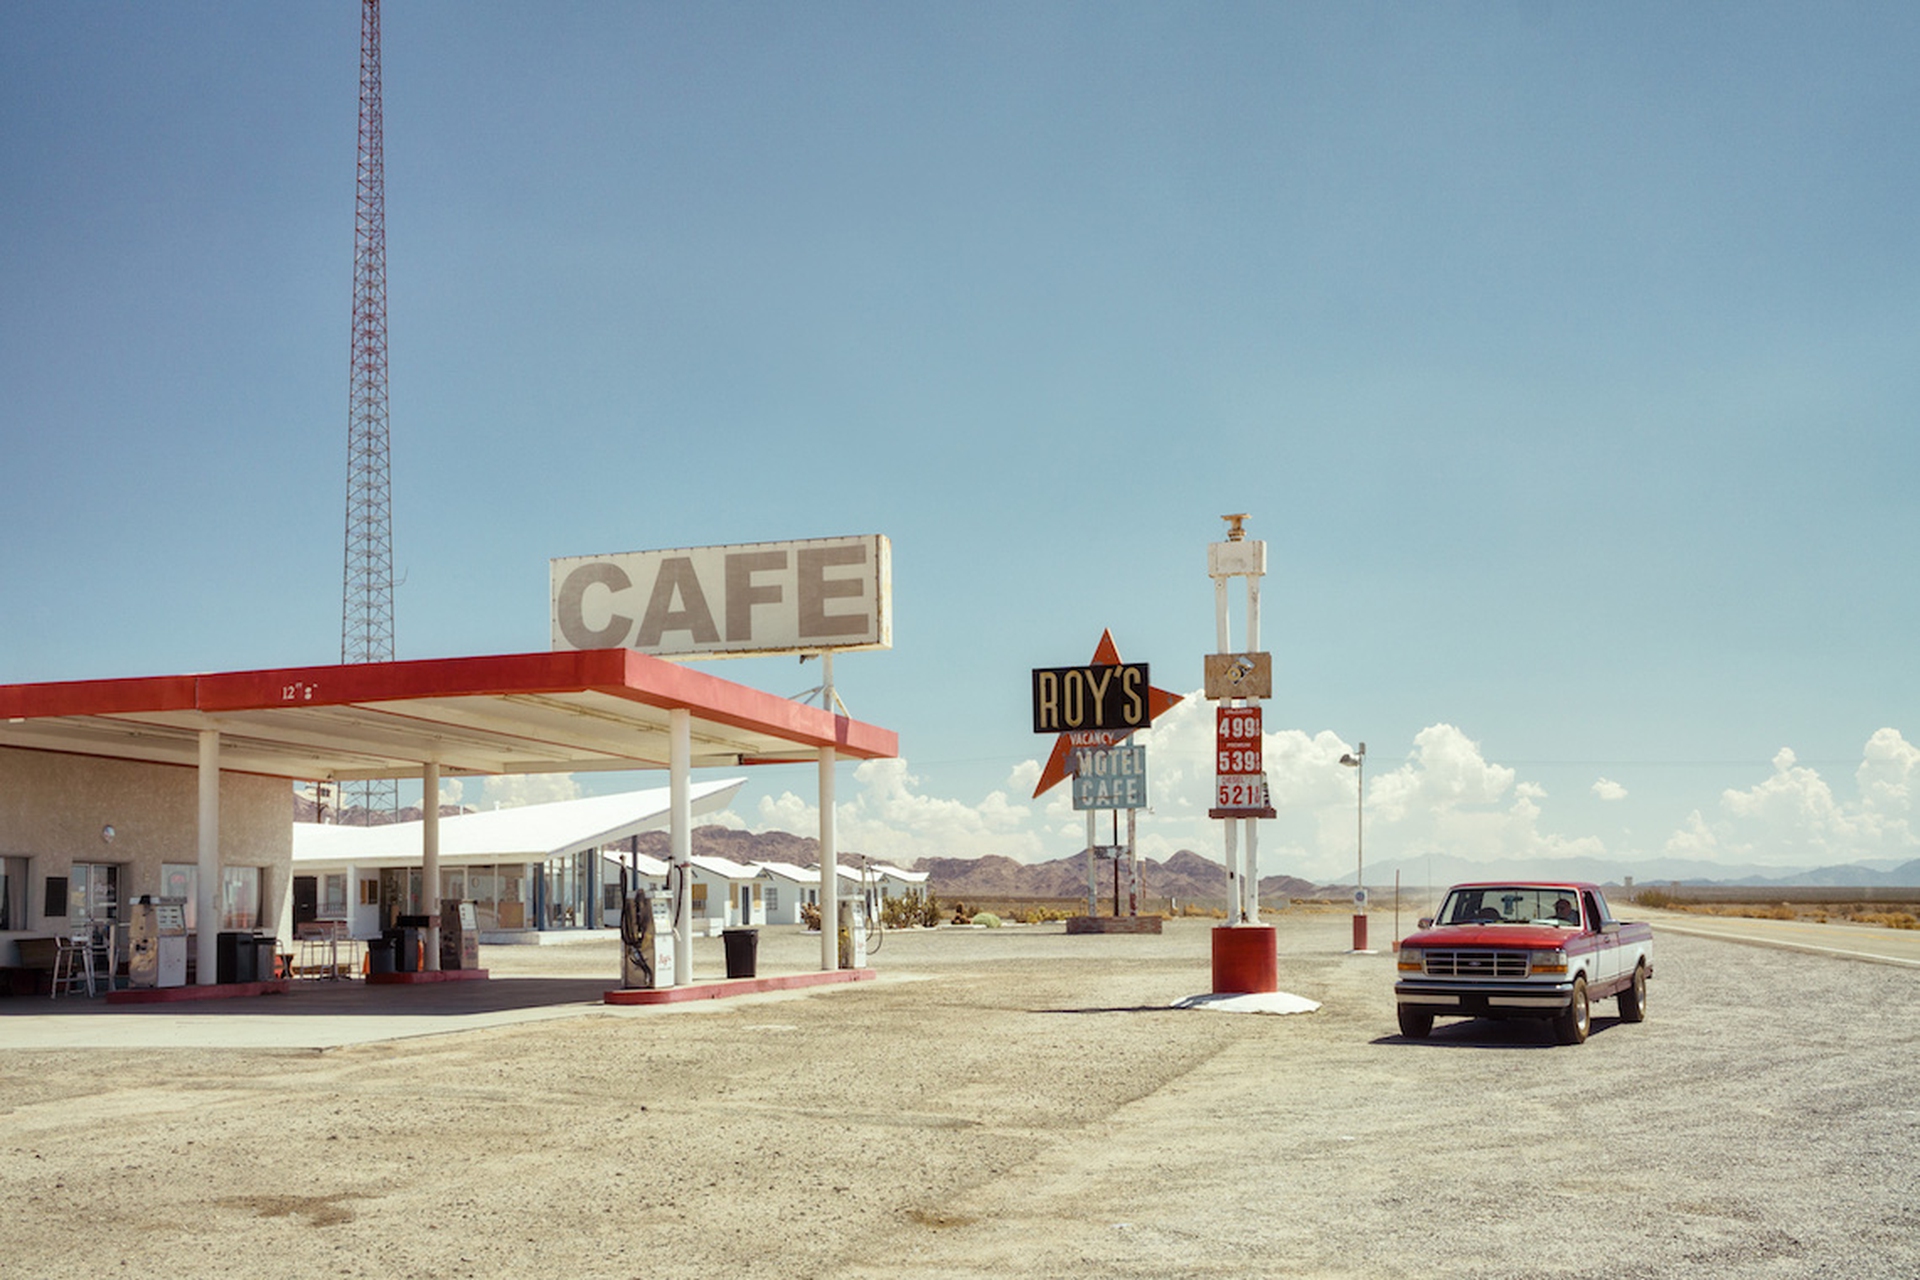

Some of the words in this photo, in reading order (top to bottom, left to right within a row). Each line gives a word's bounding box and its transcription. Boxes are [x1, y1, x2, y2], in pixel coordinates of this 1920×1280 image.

[557, 544, 869, 650] CAFE
[1039, 666, 1143, 728] ROY'S
[1069, 731, 1115, 745] VACANCY
[1076, 748, 1143, 777] MOTEL
[1082, 778, 1138, 806] CAFE
